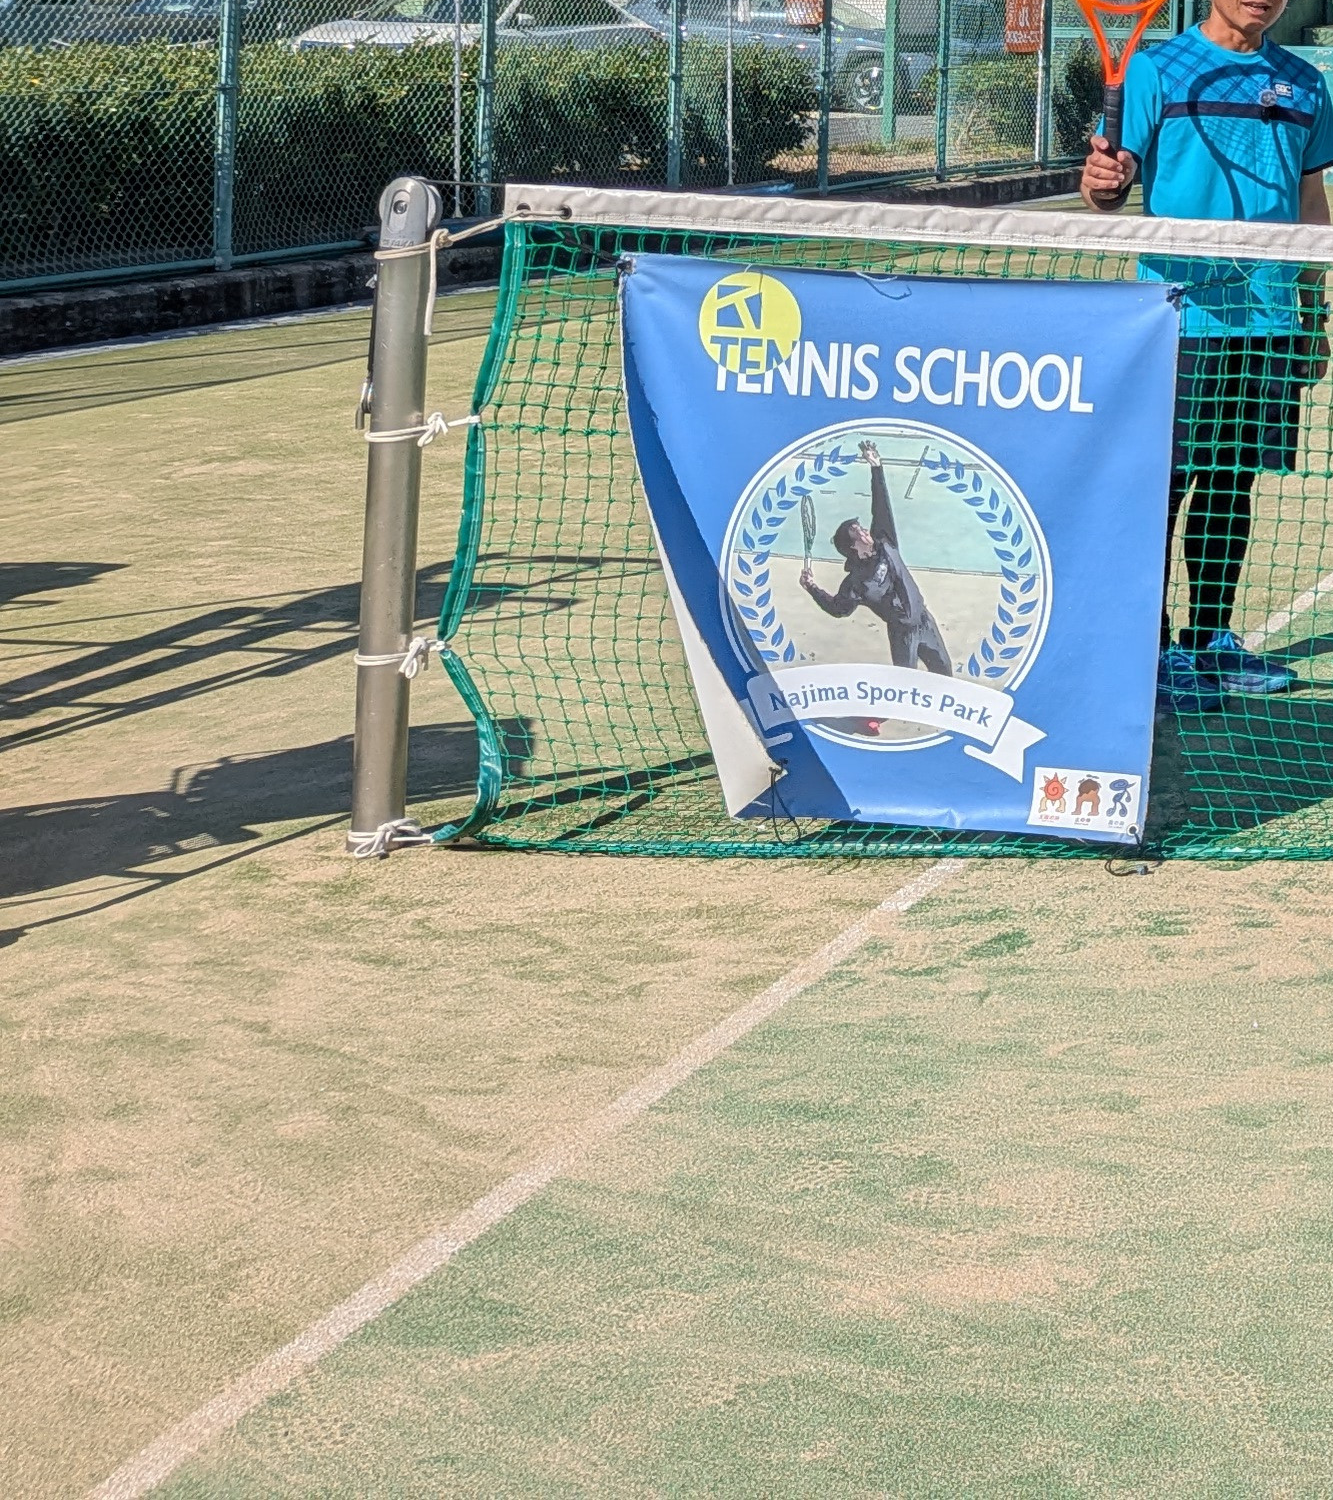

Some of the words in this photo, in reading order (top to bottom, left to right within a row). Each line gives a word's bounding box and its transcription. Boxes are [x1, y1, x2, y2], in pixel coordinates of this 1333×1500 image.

[709, 335, 880, 401] TENNIS
[893, 346, 1094, 414] SCHOOL
[768, 683, 850, 712] Najima
[856, 681, 934, 706] Sports
[938, 694, 994, 728] Park
